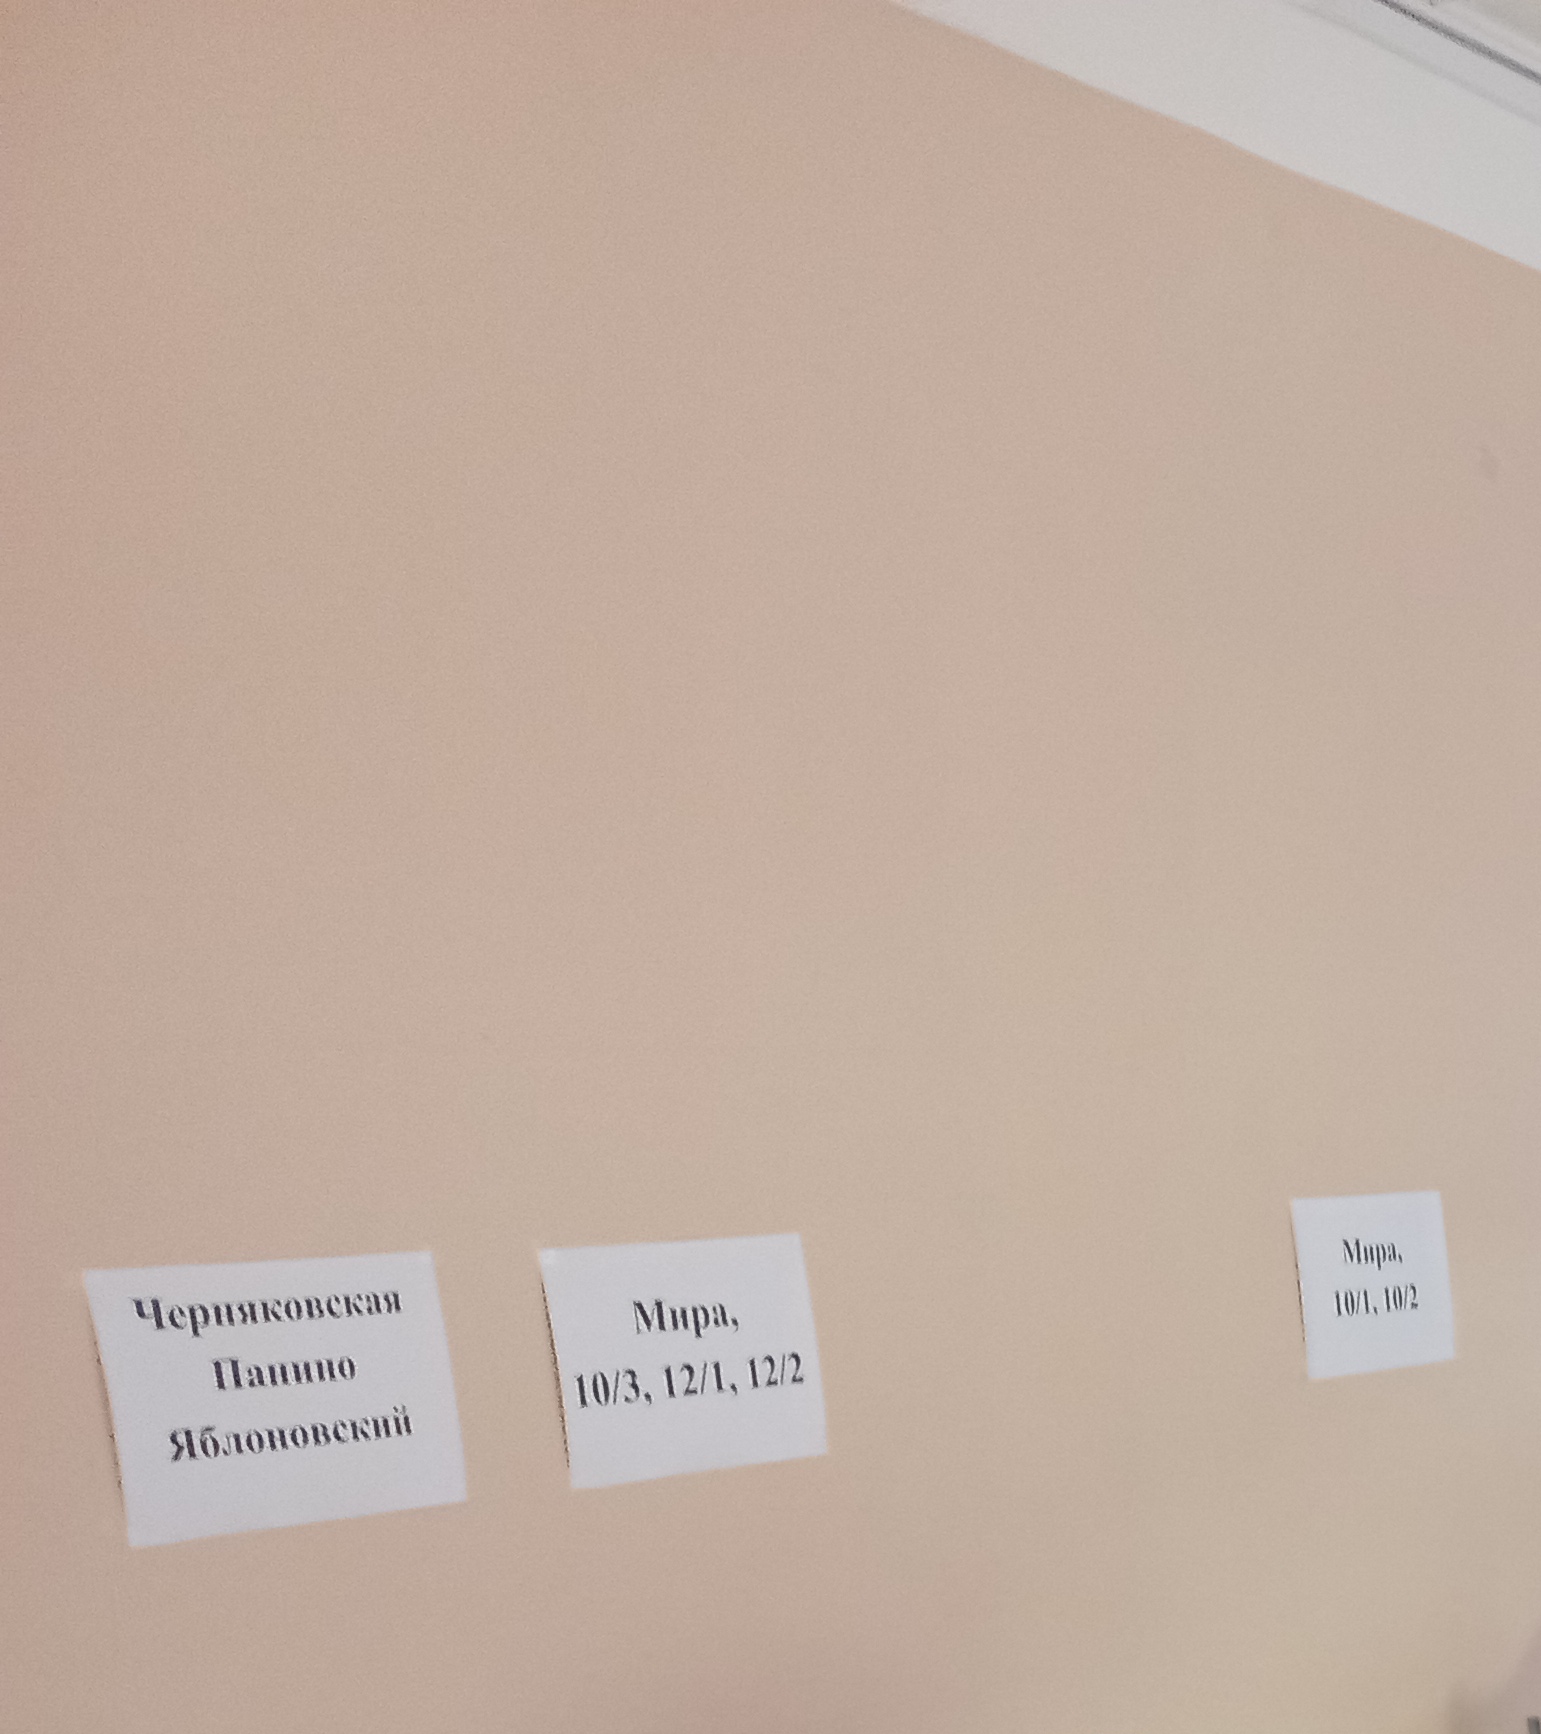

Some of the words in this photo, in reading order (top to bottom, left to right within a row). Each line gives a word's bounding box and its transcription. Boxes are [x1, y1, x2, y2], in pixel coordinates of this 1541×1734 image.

[1342, 1238, 1403, 1270] Мира,
[132, 1290, 403, 1338] Черняковская
[632, 1298, 740, 1338] Мира,
[1335, 1288, 1378, 1318] 10/1,
[1384, 1282, 1418, 1312] 10/2
[212, 1355, 357, 1391] Панино
[575, 1368, 653, 1409] 10/3,
[664, 1361, 738, 1398] 12/1,
[748, 1352, 804, 1389] 12/2
[168, 1404, 414, 1462] Яблоновский
